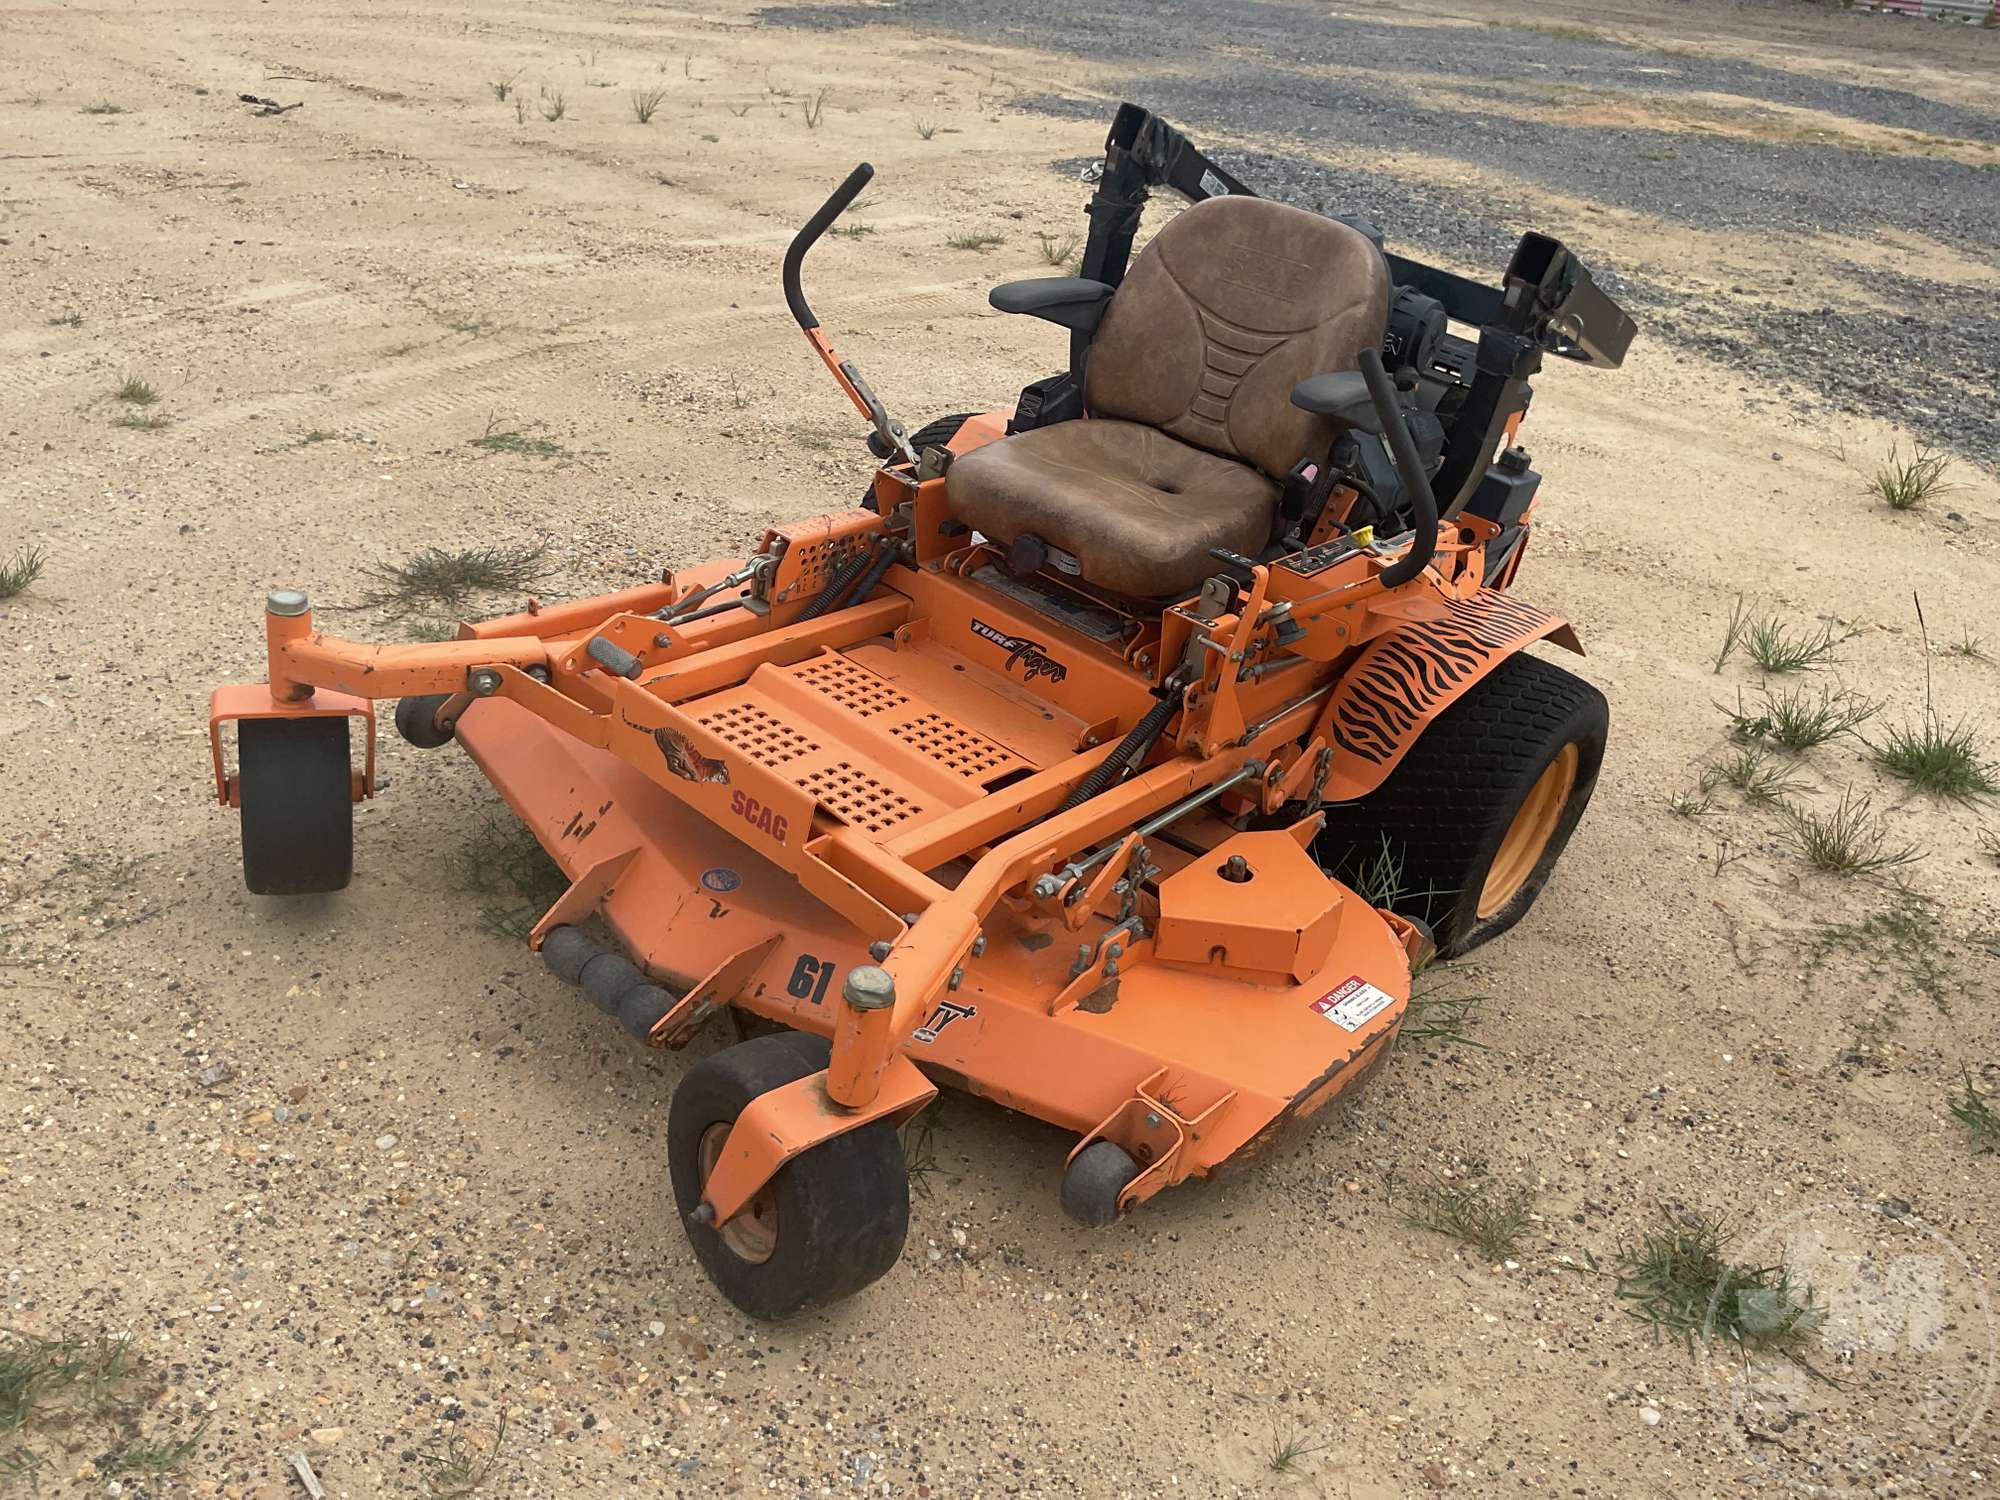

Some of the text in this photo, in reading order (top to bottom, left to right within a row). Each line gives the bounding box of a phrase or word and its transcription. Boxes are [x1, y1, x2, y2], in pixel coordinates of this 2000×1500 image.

[971, 621, 1018, 650] TURF
[730, 789, 789, 842] SCAG
[787, 953, 836, 1005] 61
[1326, 980, 1361, 1004] DANGER
